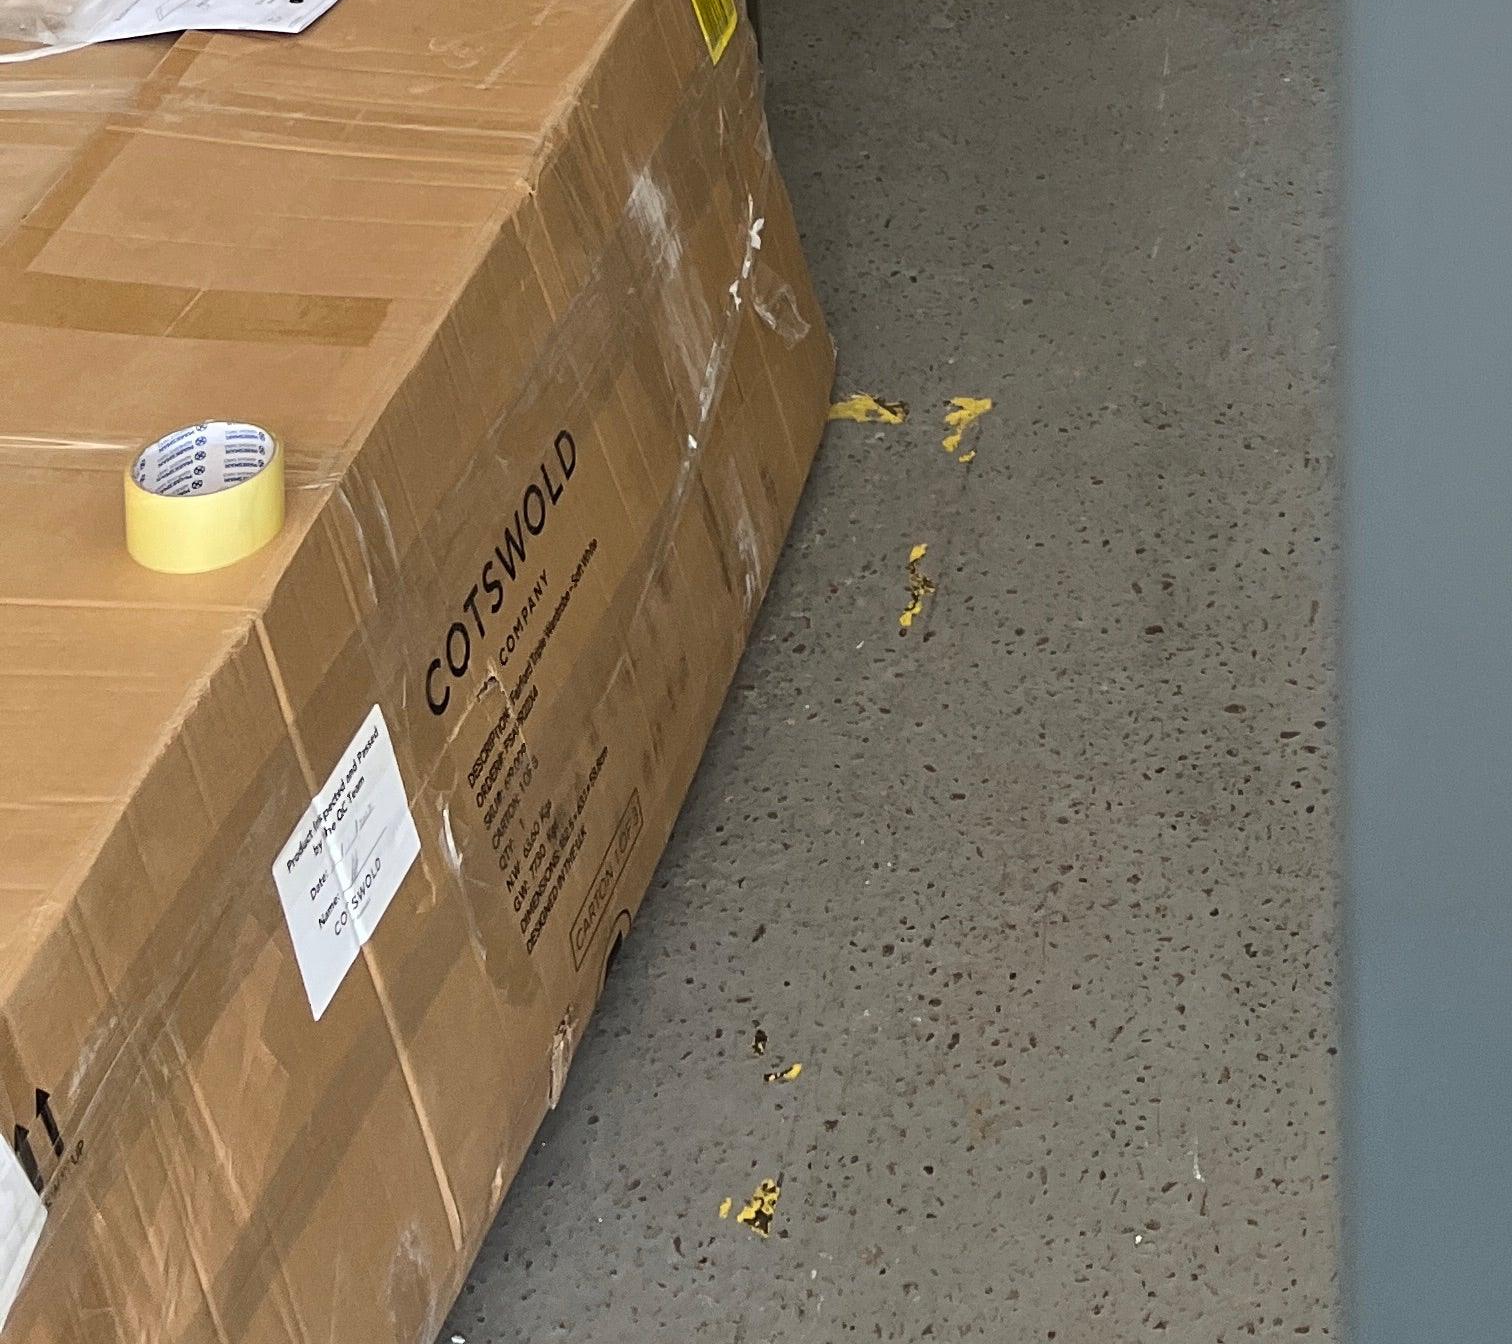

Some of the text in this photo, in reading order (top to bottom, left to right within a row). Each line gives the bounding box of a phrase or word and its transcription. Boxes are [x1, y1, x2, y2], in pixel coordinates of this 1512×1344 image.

[424, 429, 577, 716] COTSWOLD
[499, 569, 548, 666] COMPANY
[287, 830, 313, 873] Product
[346, 759, 357, 783] and
[357, 726, 379, 764] Passed
[313, 840, 322, 856] by
[337, 801, 348, 821] QC
[347, 776, 364, 803] Team
[310, 874, 326, 901] Date:
[318, 897, 340, 928] Name:
[335, 857, 381, 936] COSWOLD
[576, 865, 614, 950] CARTON
